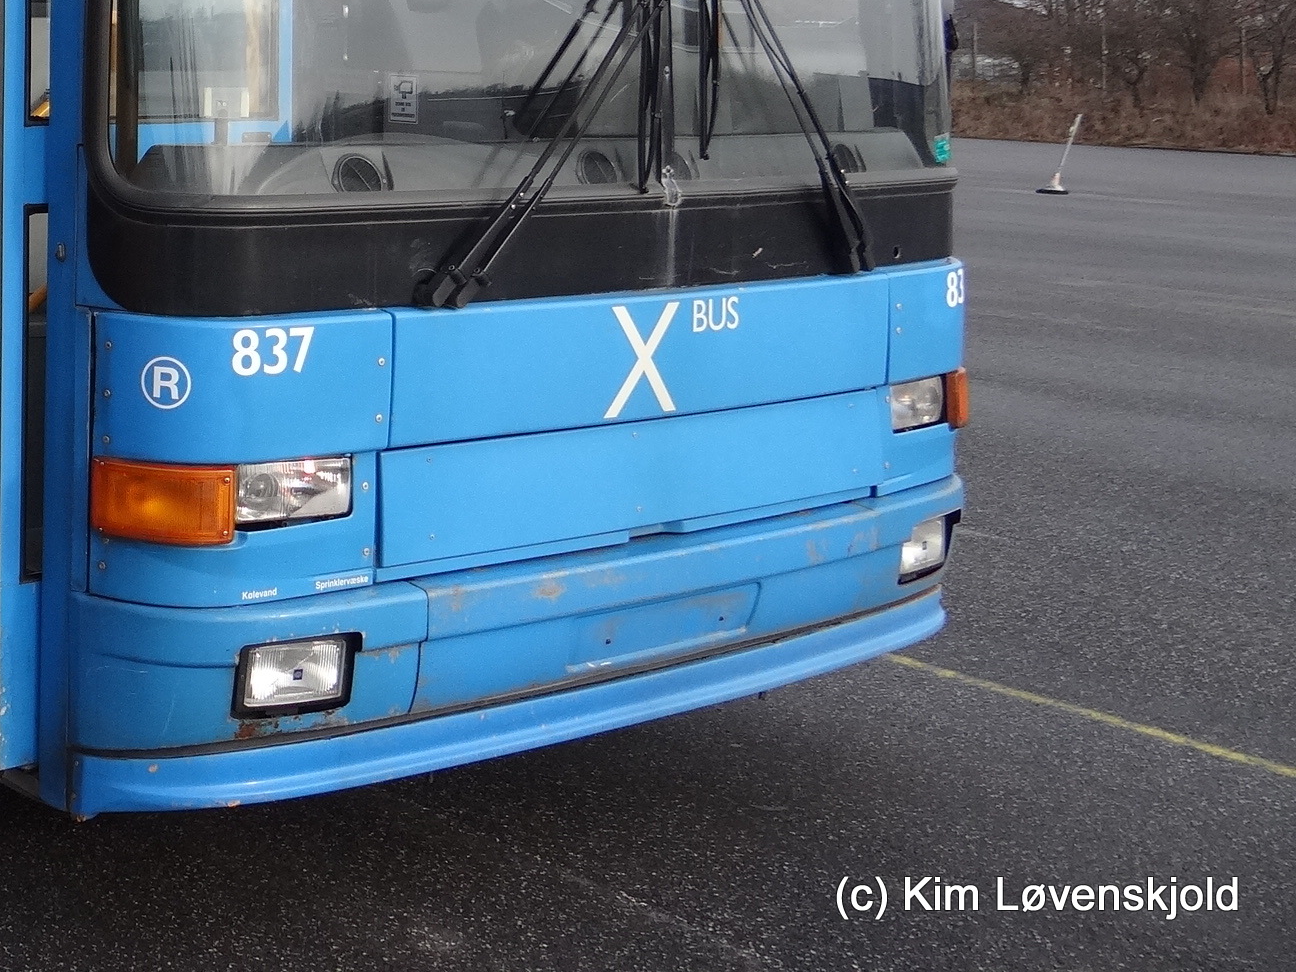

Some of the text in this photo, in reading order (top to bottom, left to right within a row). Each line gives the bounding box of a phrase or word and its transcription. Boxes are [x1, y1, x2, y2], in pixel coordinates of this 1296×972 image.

[232, 326, 315, 376] 837
[603, 296, 739, 419] X BUS
[315, 575, 369, 590] Sprinklervæske
